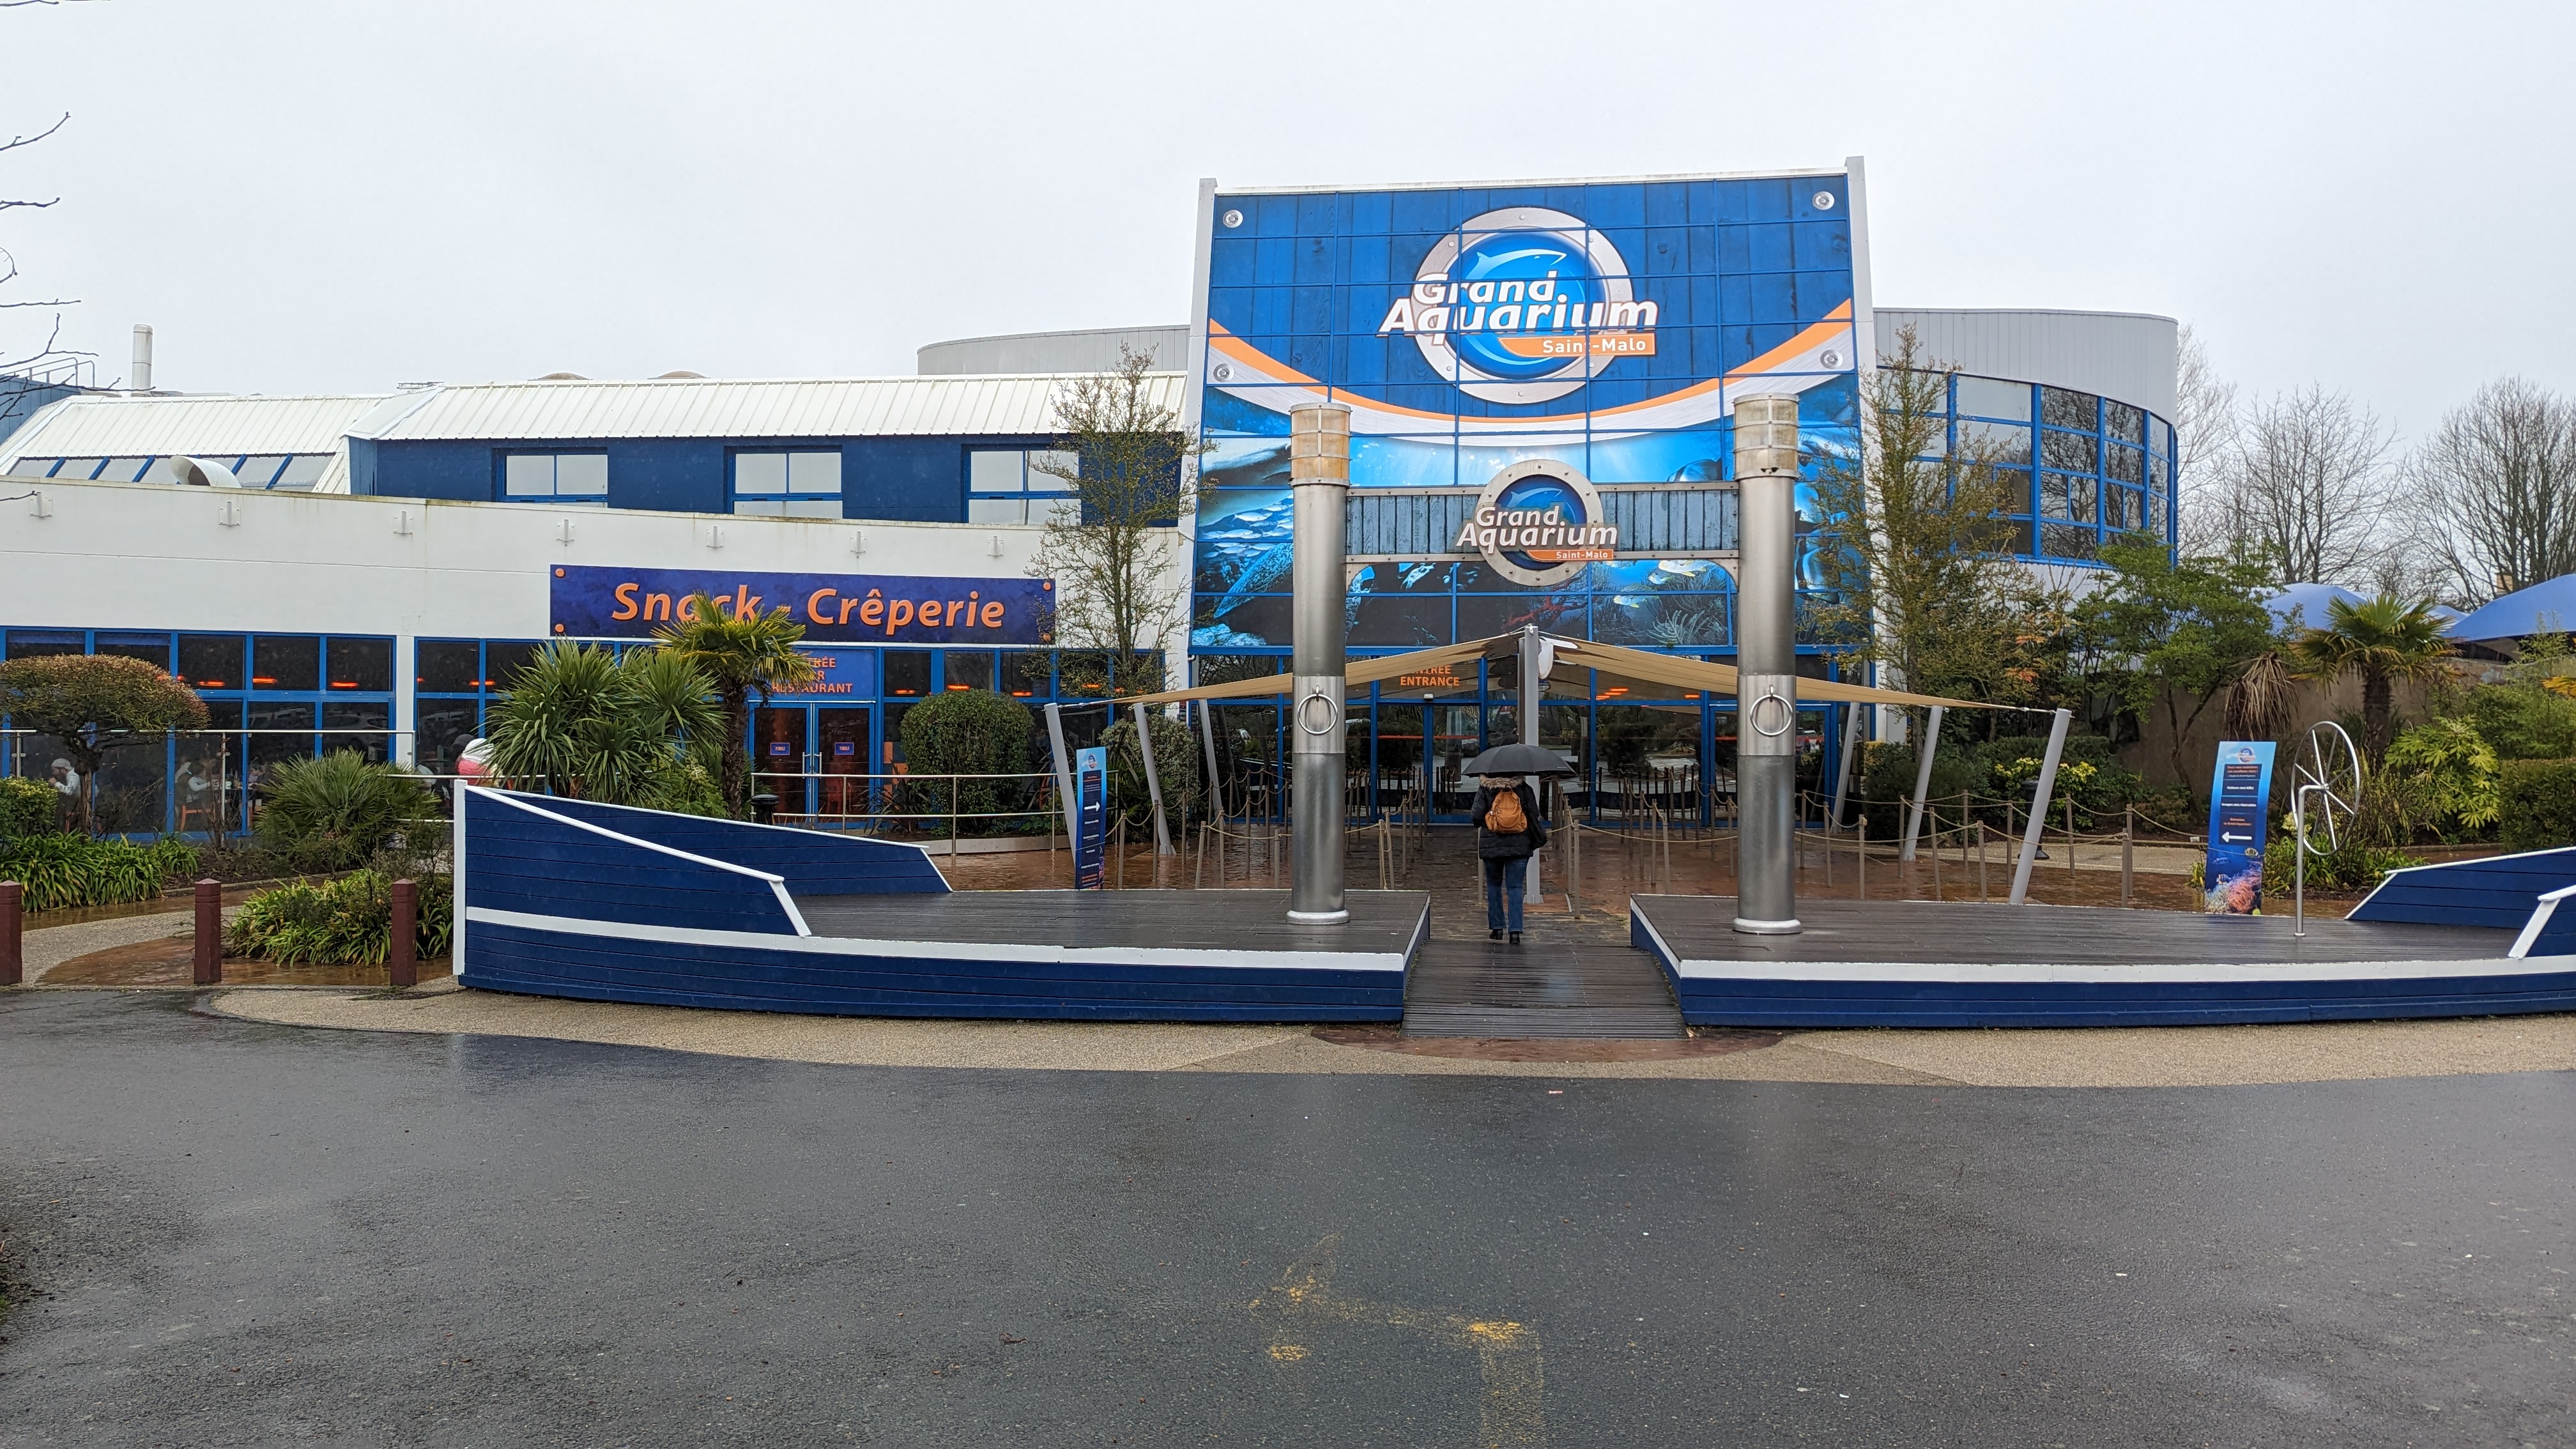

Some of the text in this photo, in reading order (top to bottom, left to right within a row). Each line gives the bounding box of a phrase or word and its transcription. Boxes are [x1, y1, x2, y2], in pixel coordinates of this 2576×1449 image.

[1413, 271, 1558, 305] Grand
[1377, 294, 1659, 346] Aquarium
[1543, 337, 1646, 353] Sain-Malo
[1476, 505, 1560, 526] Grand
[1456, 521, 1617, 554] Aquarium
[1556, 551, 1608, 559] Saint-Malo
[808, 588, 1005, 636] Crêperie
[772, 682, 853, 693] RESAURANT
[1400, 677, 1460, 686] ENTRANCE
